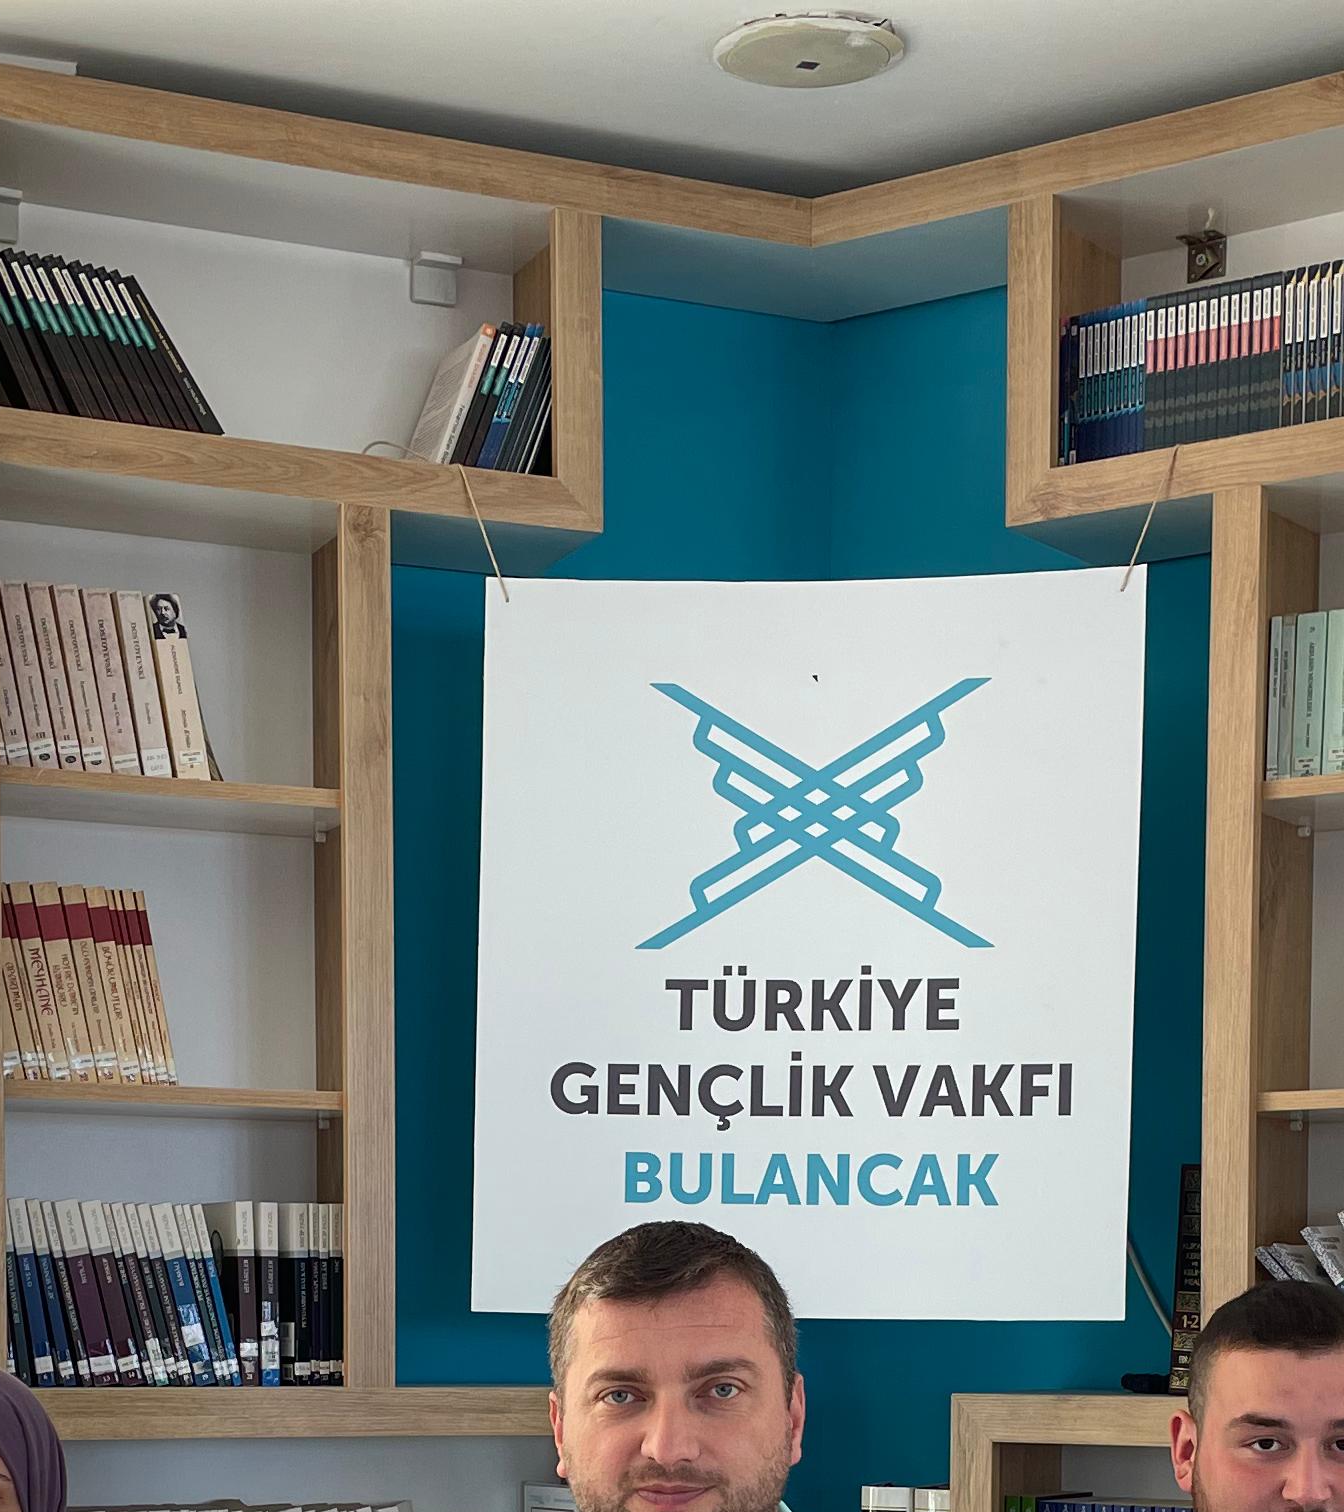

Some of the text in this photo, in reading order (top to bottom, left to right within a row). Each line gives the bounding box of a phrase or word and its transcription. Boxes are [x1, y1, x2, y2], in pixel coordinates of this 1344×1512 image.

[666, 966, 961, 1031] TÜRKİYE
[550, 1051, 1074, 1130] GENÇLİK VAKFI
[624, 1152, 999, 1206] BULANCAK
